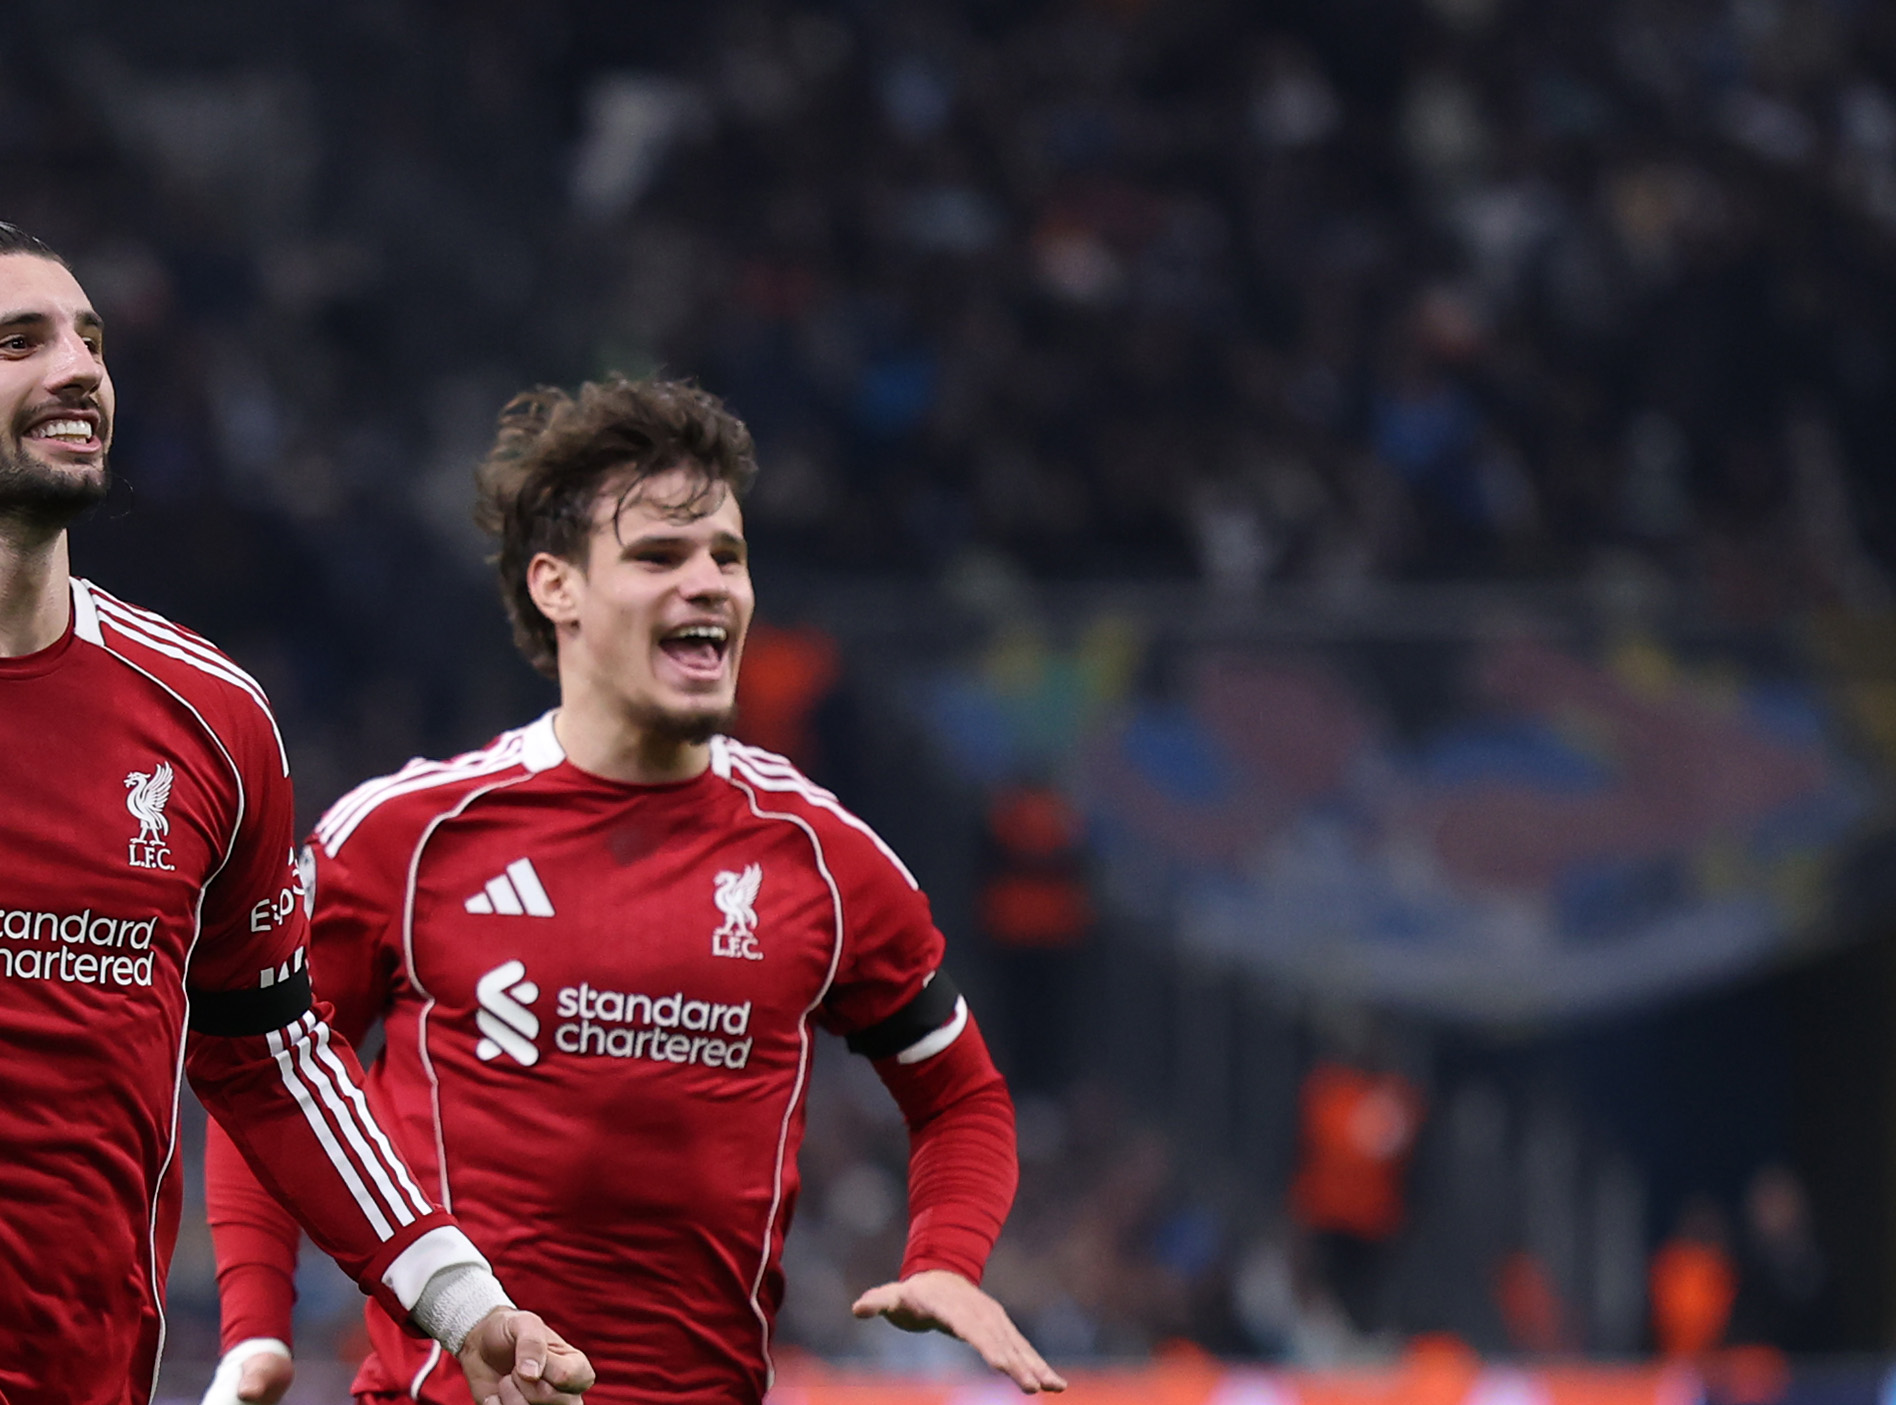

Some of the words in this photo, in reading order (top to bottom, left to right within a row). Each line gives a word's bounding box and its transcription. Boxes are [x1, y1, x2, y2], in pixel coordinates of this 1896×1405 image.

[129, 844, 175, 871] L.F.C.
[557, 982, 752, 1036] standard
[555, 1019, 753, 1070] chartered
